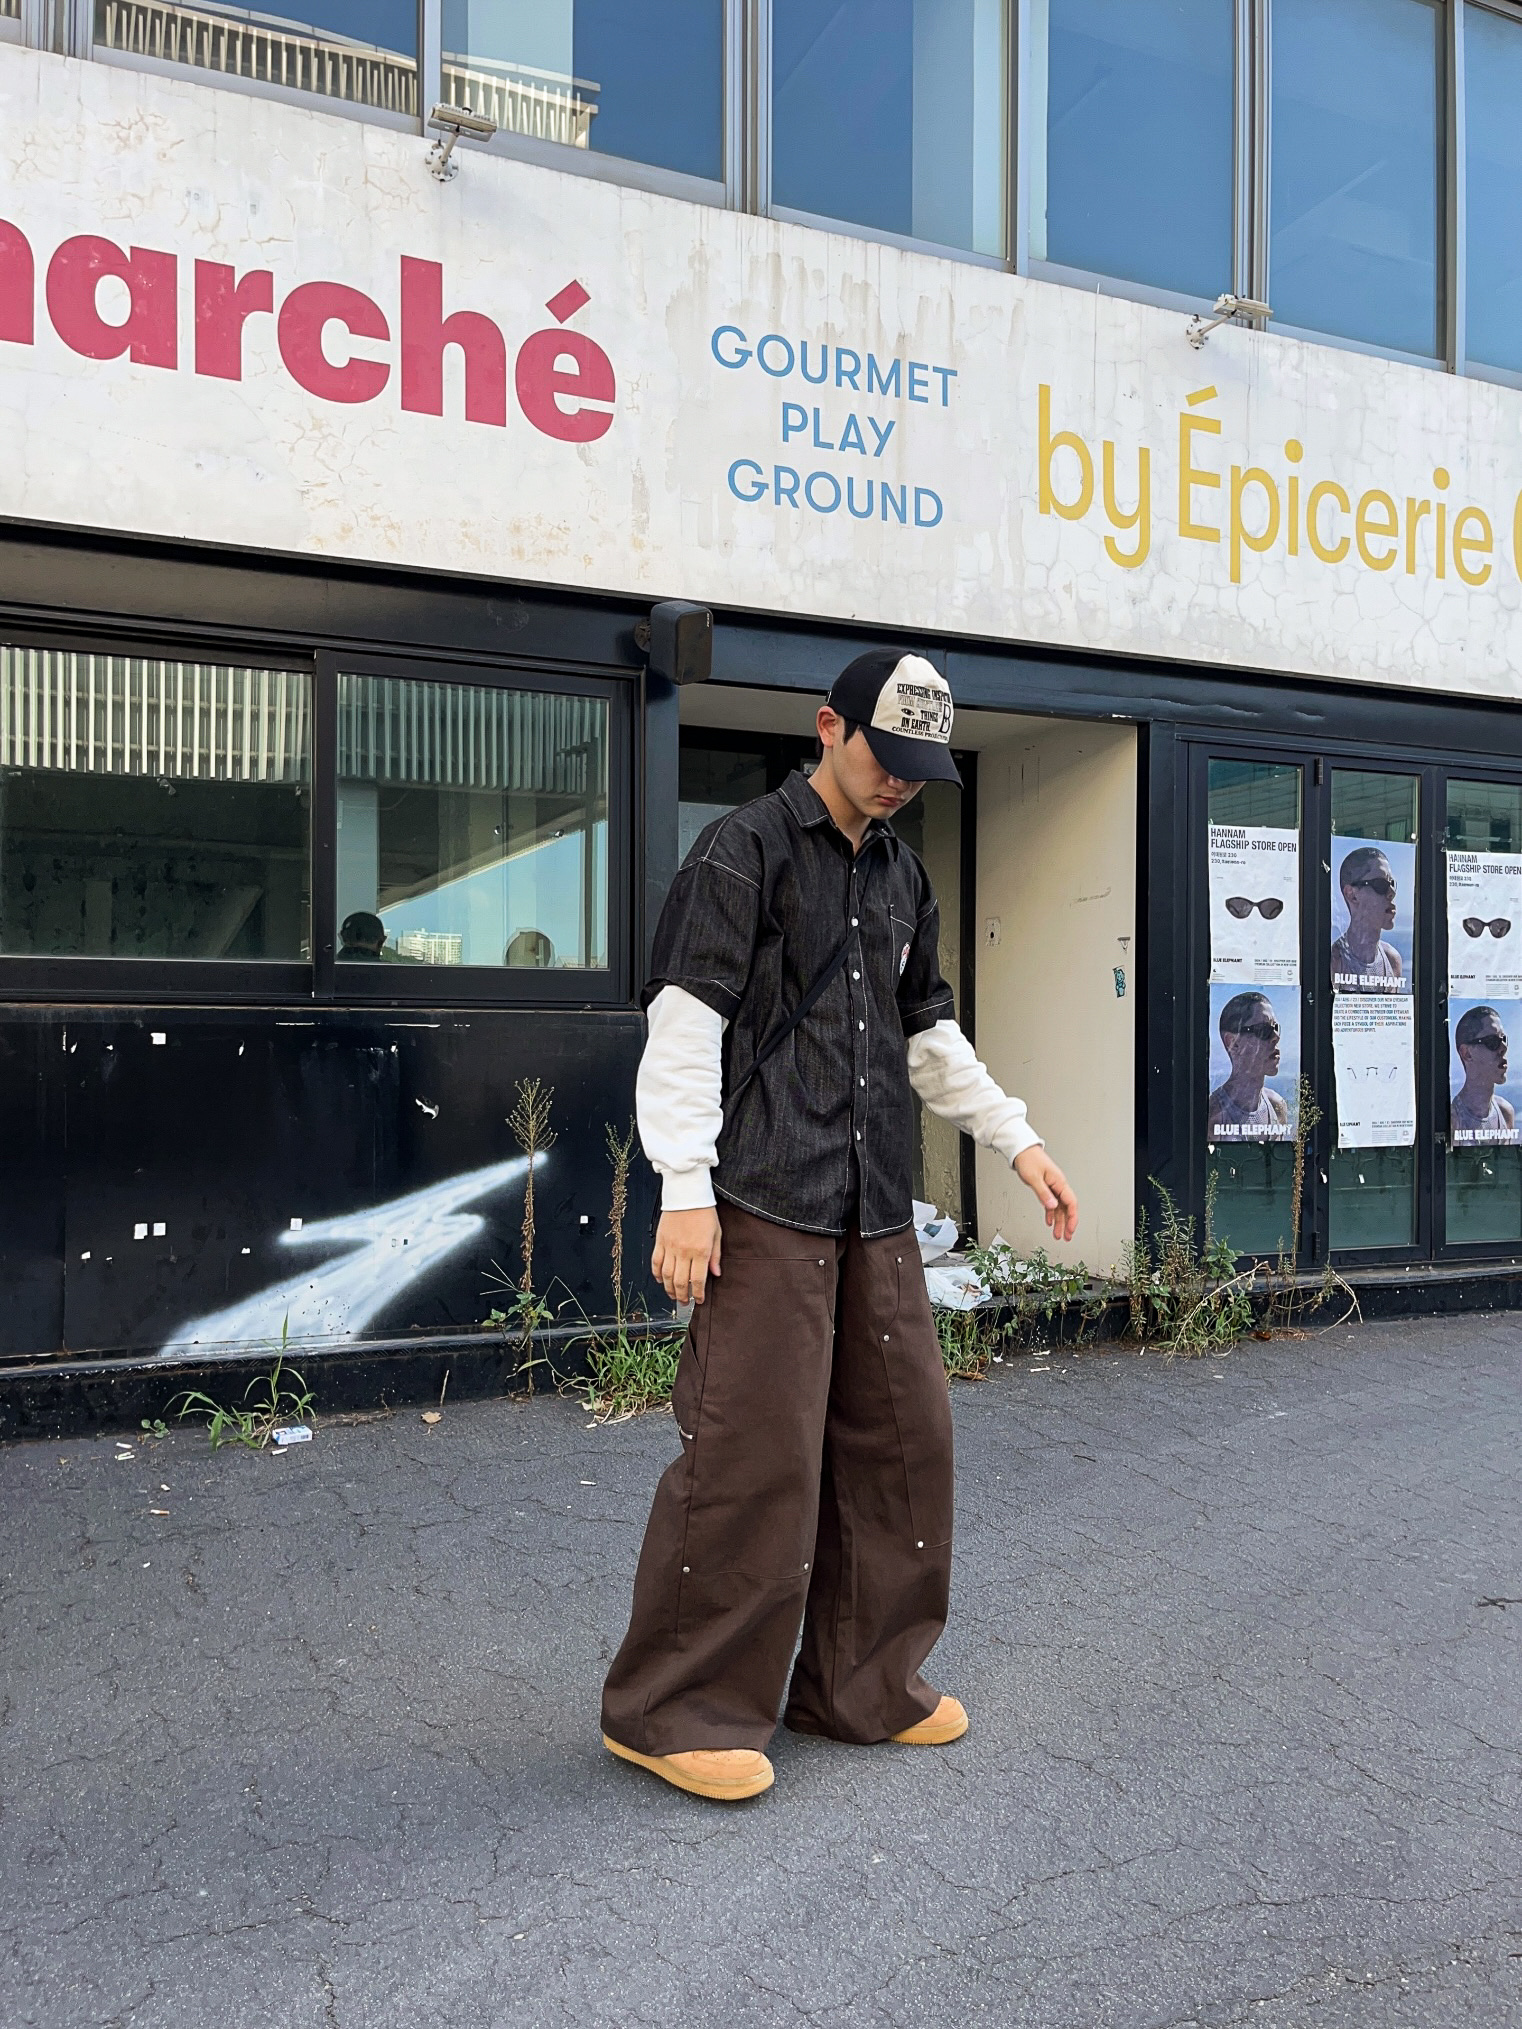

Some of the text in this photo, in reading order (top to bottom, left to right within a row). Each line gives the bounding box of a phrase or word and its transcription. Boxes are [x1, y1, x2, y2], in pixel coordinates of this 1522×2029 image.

[0, 219, 614, 442] arché
[711, 325, 957, 407] GOURMET
[782, 403, 896, 457] PLAY
[1039, 384, 1151, 569] by
[1179, 385, 1493, 585] Épicerie
[727, 459, 943, 528] GROUND
[897, 684, 931, 699] EXPRESSING
[892, 727, 924, 736] COUNTLESS
[901, 717, 931, 732] ON EARTH
[1211, 828, 1246, 839] HANNAM
[1211, 839, 1297, 852] FLAGSHIP STORE OPEN
[1448, 853, 1478, 864] HANNAM
[1449, 863, 1522, 876] FLAGSHIP STORE OPEN
[1334, 973, 1406, 987] BLUE ELEPHANT
[1213, 1123, 1293, 1136] BLUE ELEPHANT
[1454, 1128, 1520, 1141] BLUE ELEPHANT
